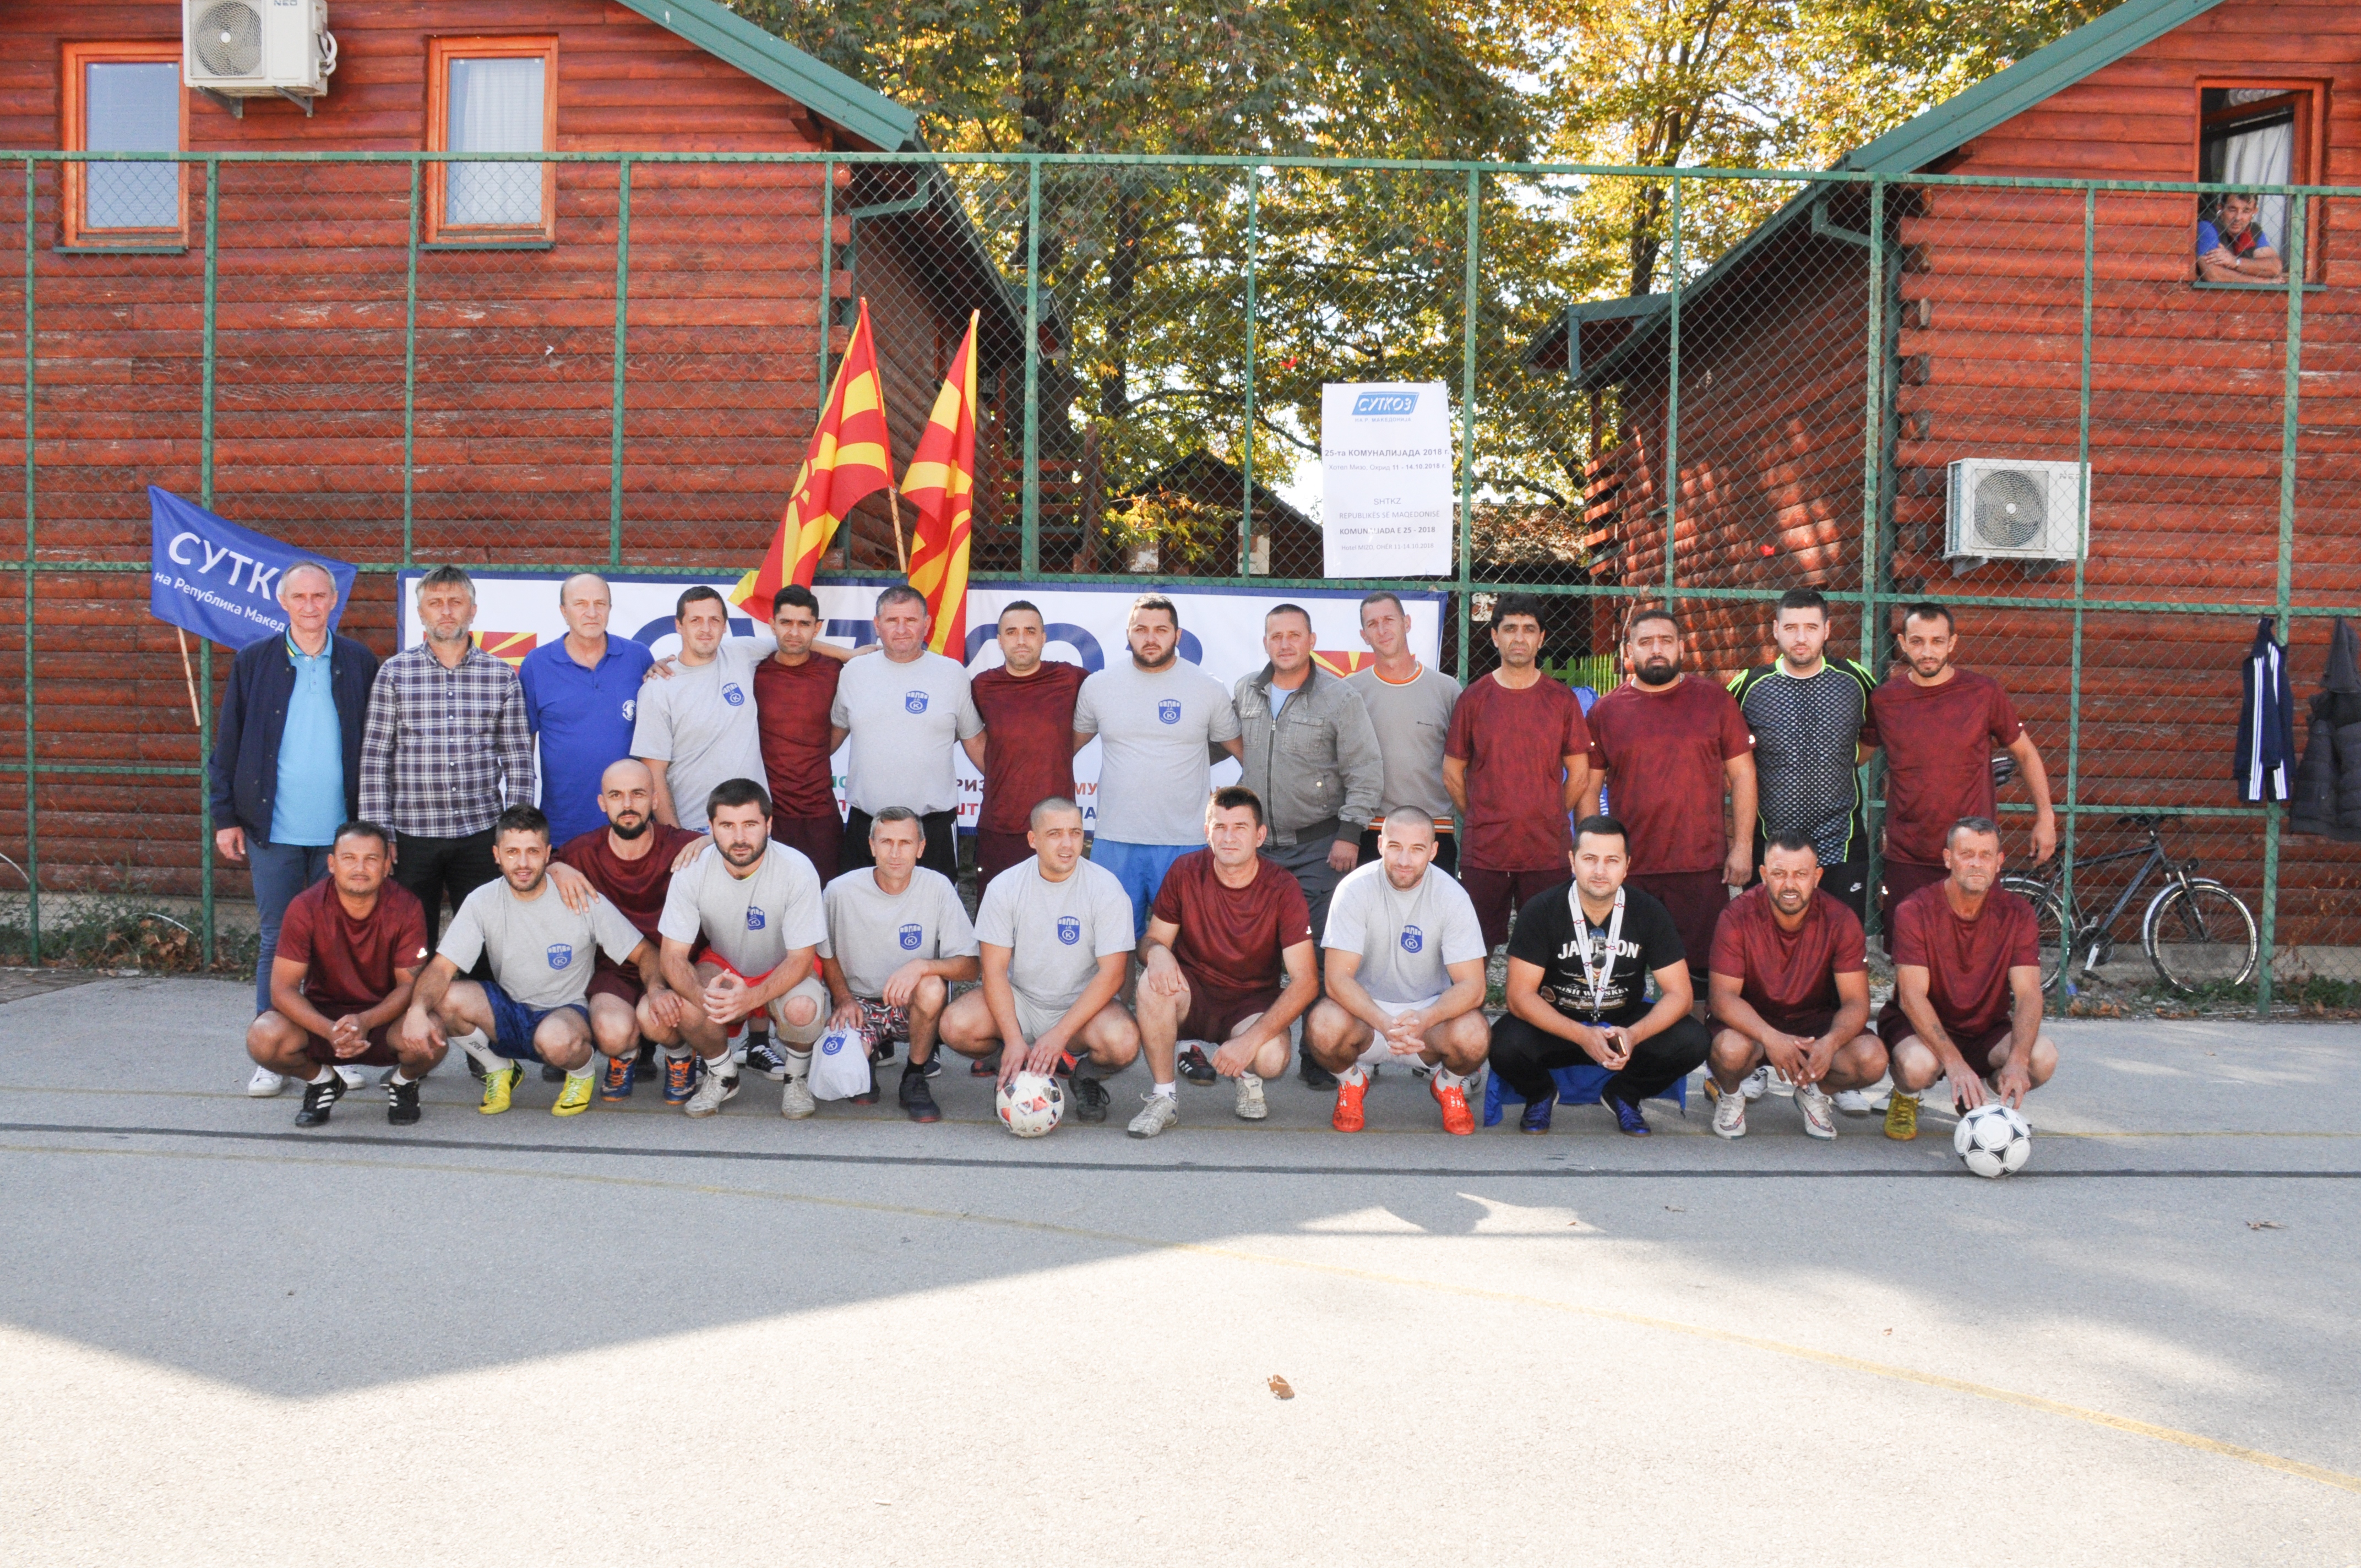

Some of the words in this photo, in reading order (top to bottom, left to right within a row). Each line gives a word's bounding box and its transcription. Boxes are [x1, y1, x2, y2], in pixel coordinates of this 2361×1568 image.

[1358, 396, 1412, 411] СУТКОЗ
[1392, 510, 1440, 518] MAQEDONISË
[168, 532, 287, 612] СУТК
[154, 572, 171, 585] на
[173, 578, 242, 616] Република
[244, 606, 286, 633] Макед
